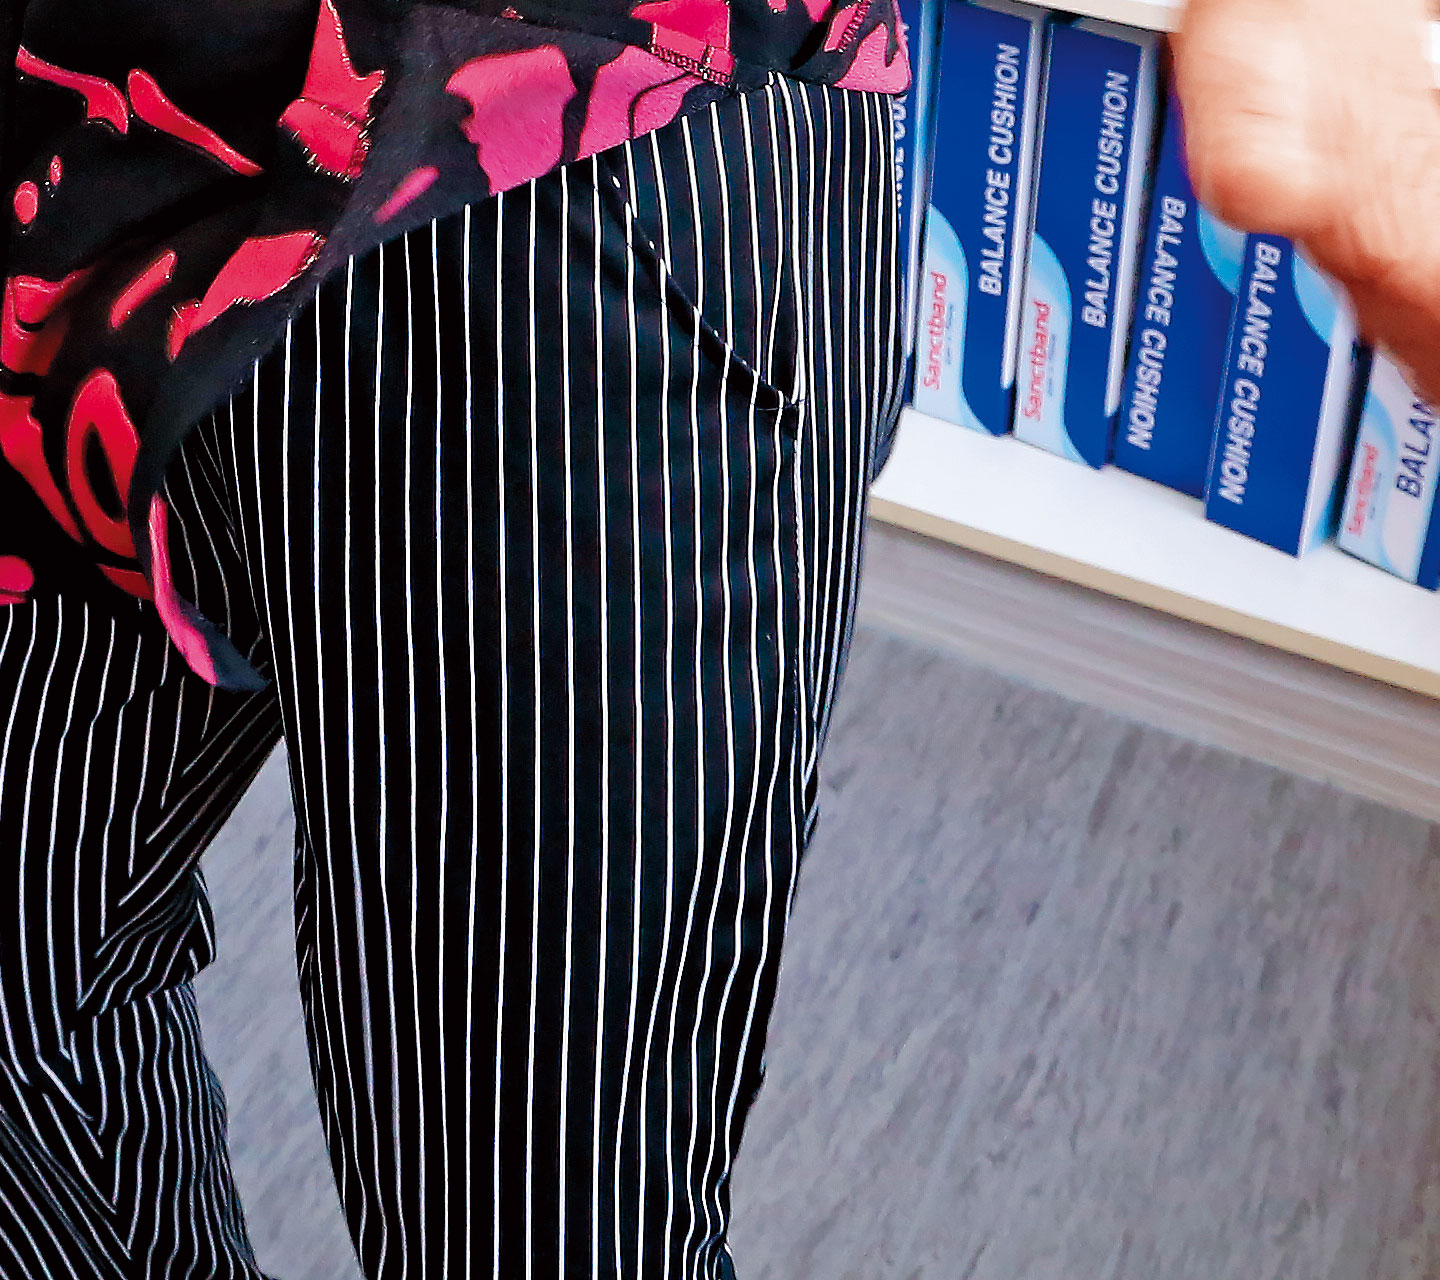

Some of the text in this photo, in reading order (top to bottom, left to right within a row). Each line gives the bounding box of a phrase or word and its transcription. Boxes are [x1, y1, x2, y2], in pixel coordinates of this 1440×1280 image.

[977, 42, 1021, 297] BALANCE CUSHION
[1080, 69, 1130, 328] BALANCE CUSHION
[1126, 194, 1188, 451] BALANCE CUSHION
[1216, 240, 1282, 505] BALANCE CUSHION
